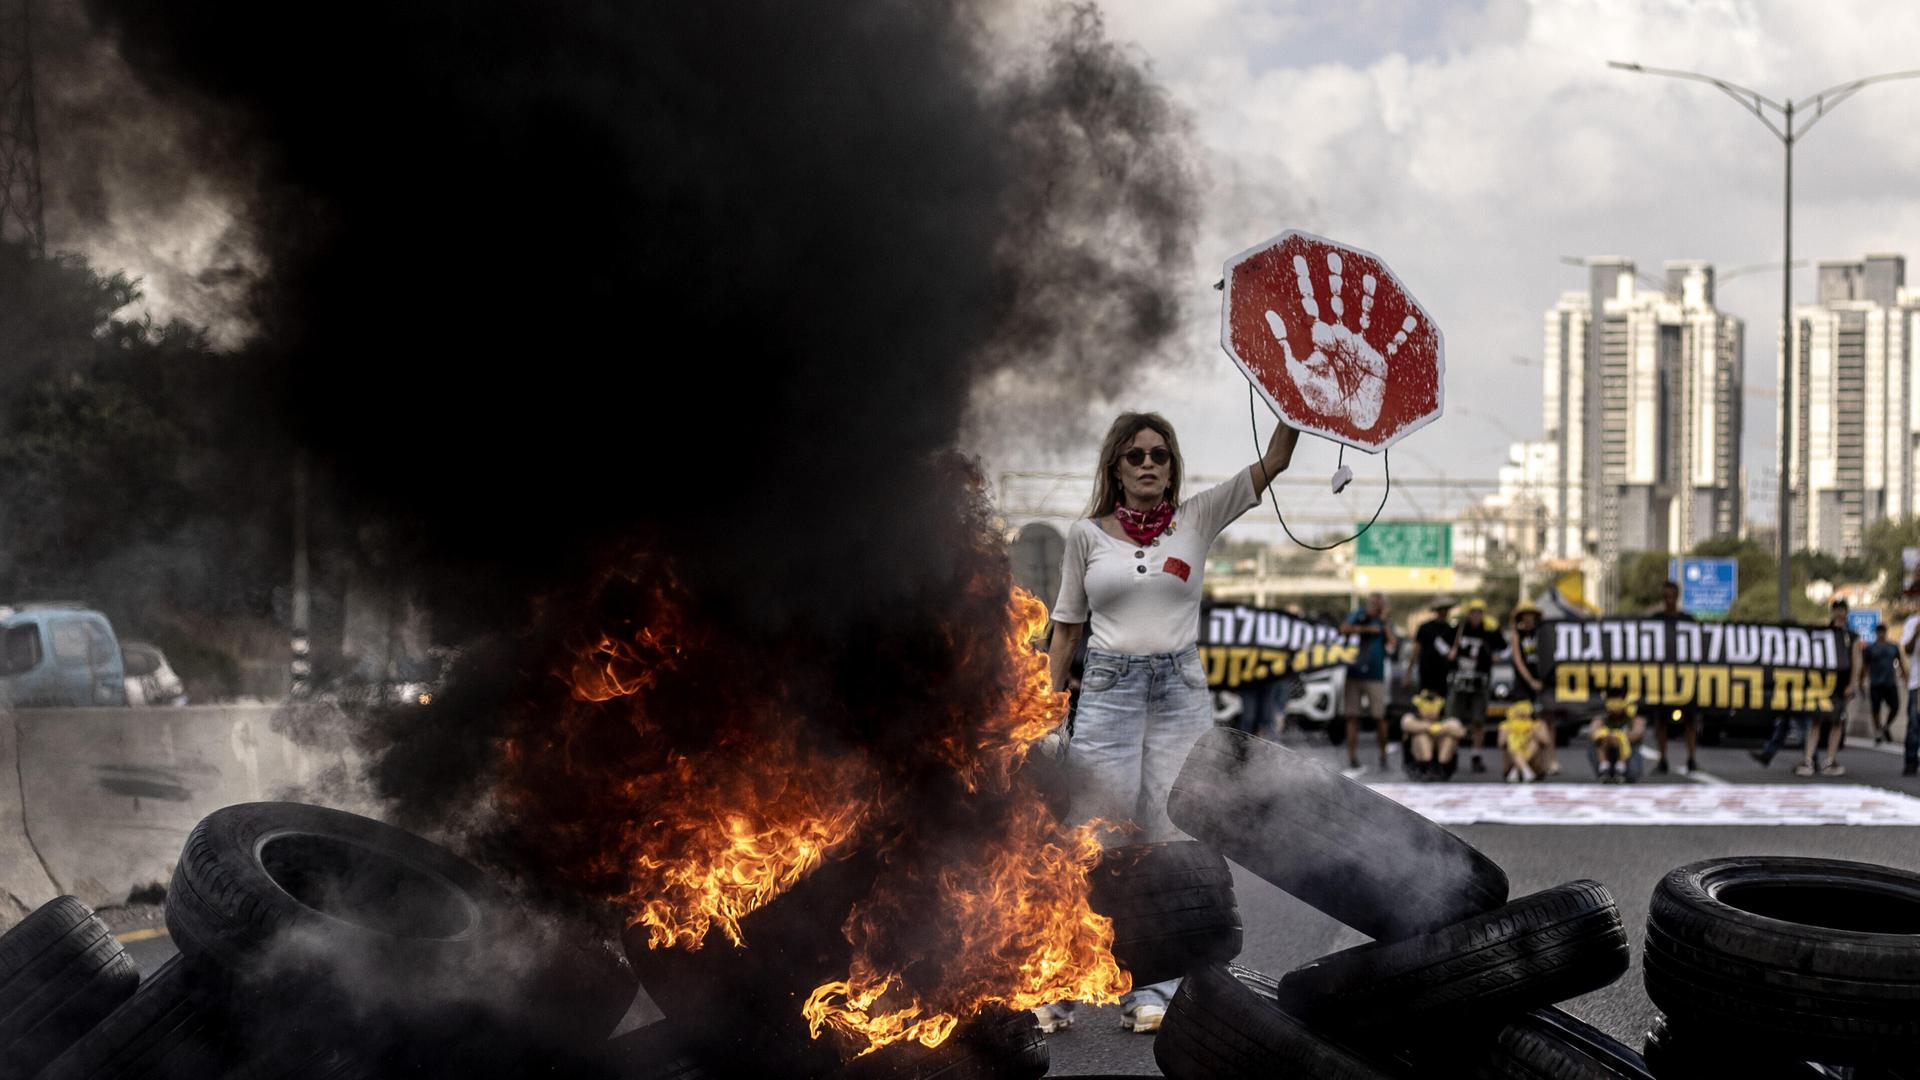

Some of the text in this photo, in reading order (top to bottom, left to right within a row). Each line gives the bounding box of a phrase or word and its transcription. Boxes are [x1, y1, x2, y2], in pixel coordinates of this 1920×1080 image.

[1554, 620, 1665, 661] הורגת
[1676, 622, 1838, 669] הממשלה
[1555, 663, 1838, 712] את החטופים
